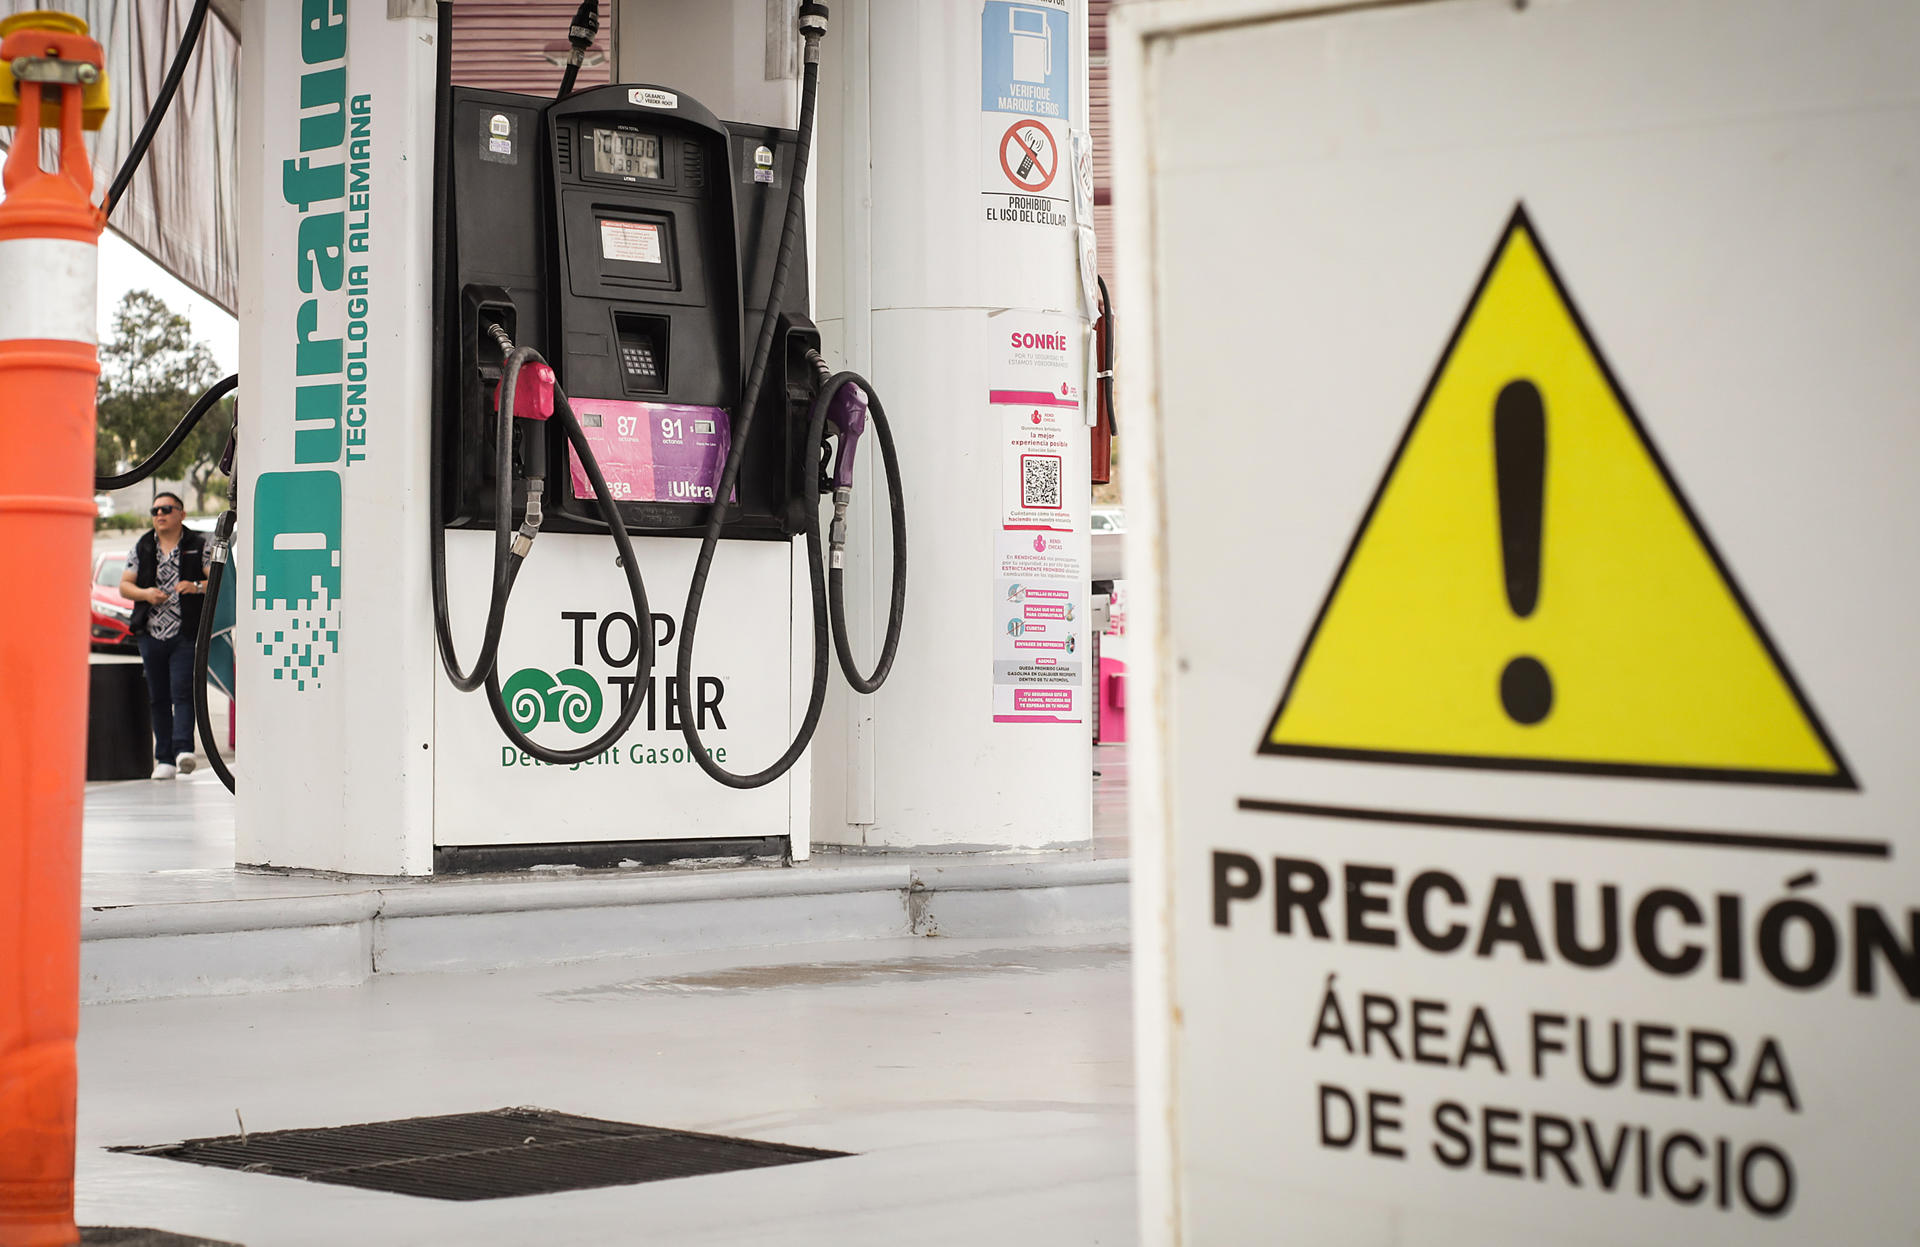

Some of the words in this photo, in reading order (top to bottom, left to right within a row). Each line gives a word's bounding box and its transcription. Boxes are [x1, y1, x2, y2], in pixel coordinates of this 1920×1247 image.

[1010, 83, 1050, 100] VERIFIQUE
[998, 96, 1034, 112] MARQUE
[1036, 100, 1059, 116] CEROS
[349, 94, 372, 253] ALEMANA
[1009, 196, 1051, 212] PROHIBIDO
[986, 208, 998, 220] EL
[1000, 208, 1018, 221] USO
[1020, 209, 1035, 223] DEL
[1036, 211, 1067, 227] CELULAR
[1011, 330, 1066, 351] SONRÍE
[345, 266, 369, 467] TECNOLOGIA
[617, 415, 637, 436] 87
[661, 418, 683, 439] 91
[1011, 439, 1049, 447] experiencia
[673, 480, 714, 498] Ultra
[561, 611, 676, 668] TOP
[608, 676, 727, 731] TIER
[1210, 850, 1920, 1001] PRECAUCIÓN
[1310, 972, 1508, 1075] ÁREA
[1528, 1012, 1804, 1112] FUERA
[1317, 1083, 1406, 1160] DE
[1430, 1101, 1797, 1218] SERVICIO
